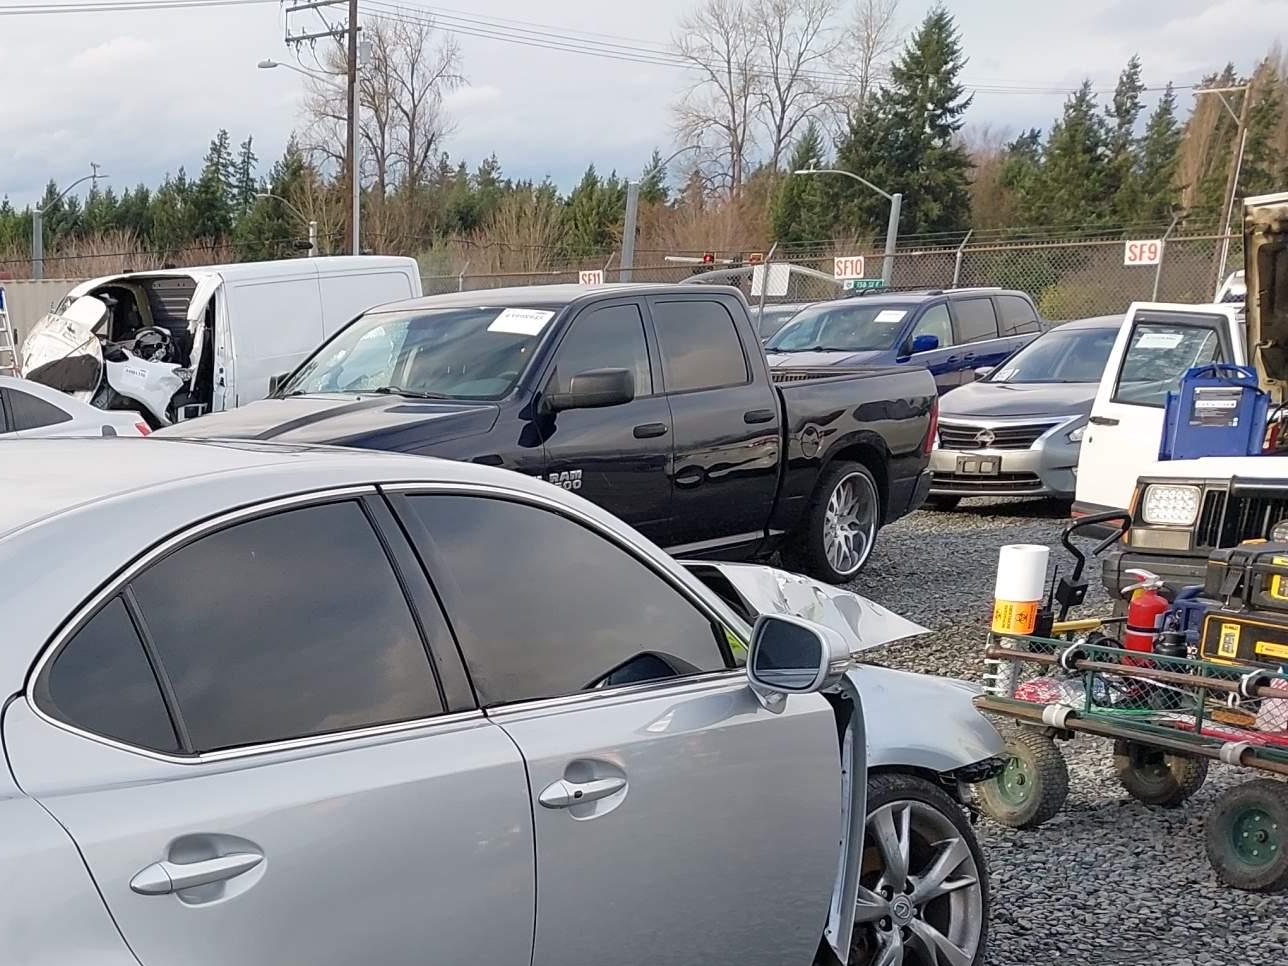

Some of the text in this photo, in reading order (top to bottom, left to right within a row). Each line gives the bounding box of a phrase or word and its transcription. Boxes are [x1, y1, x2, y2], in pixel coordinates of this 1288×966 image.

[1128, 243, 1158, 262] SF9
[836, 259, 863, 276] SF10
[581, 272, 600, 285] SF11
[549, 469, 582, 483] RAM
